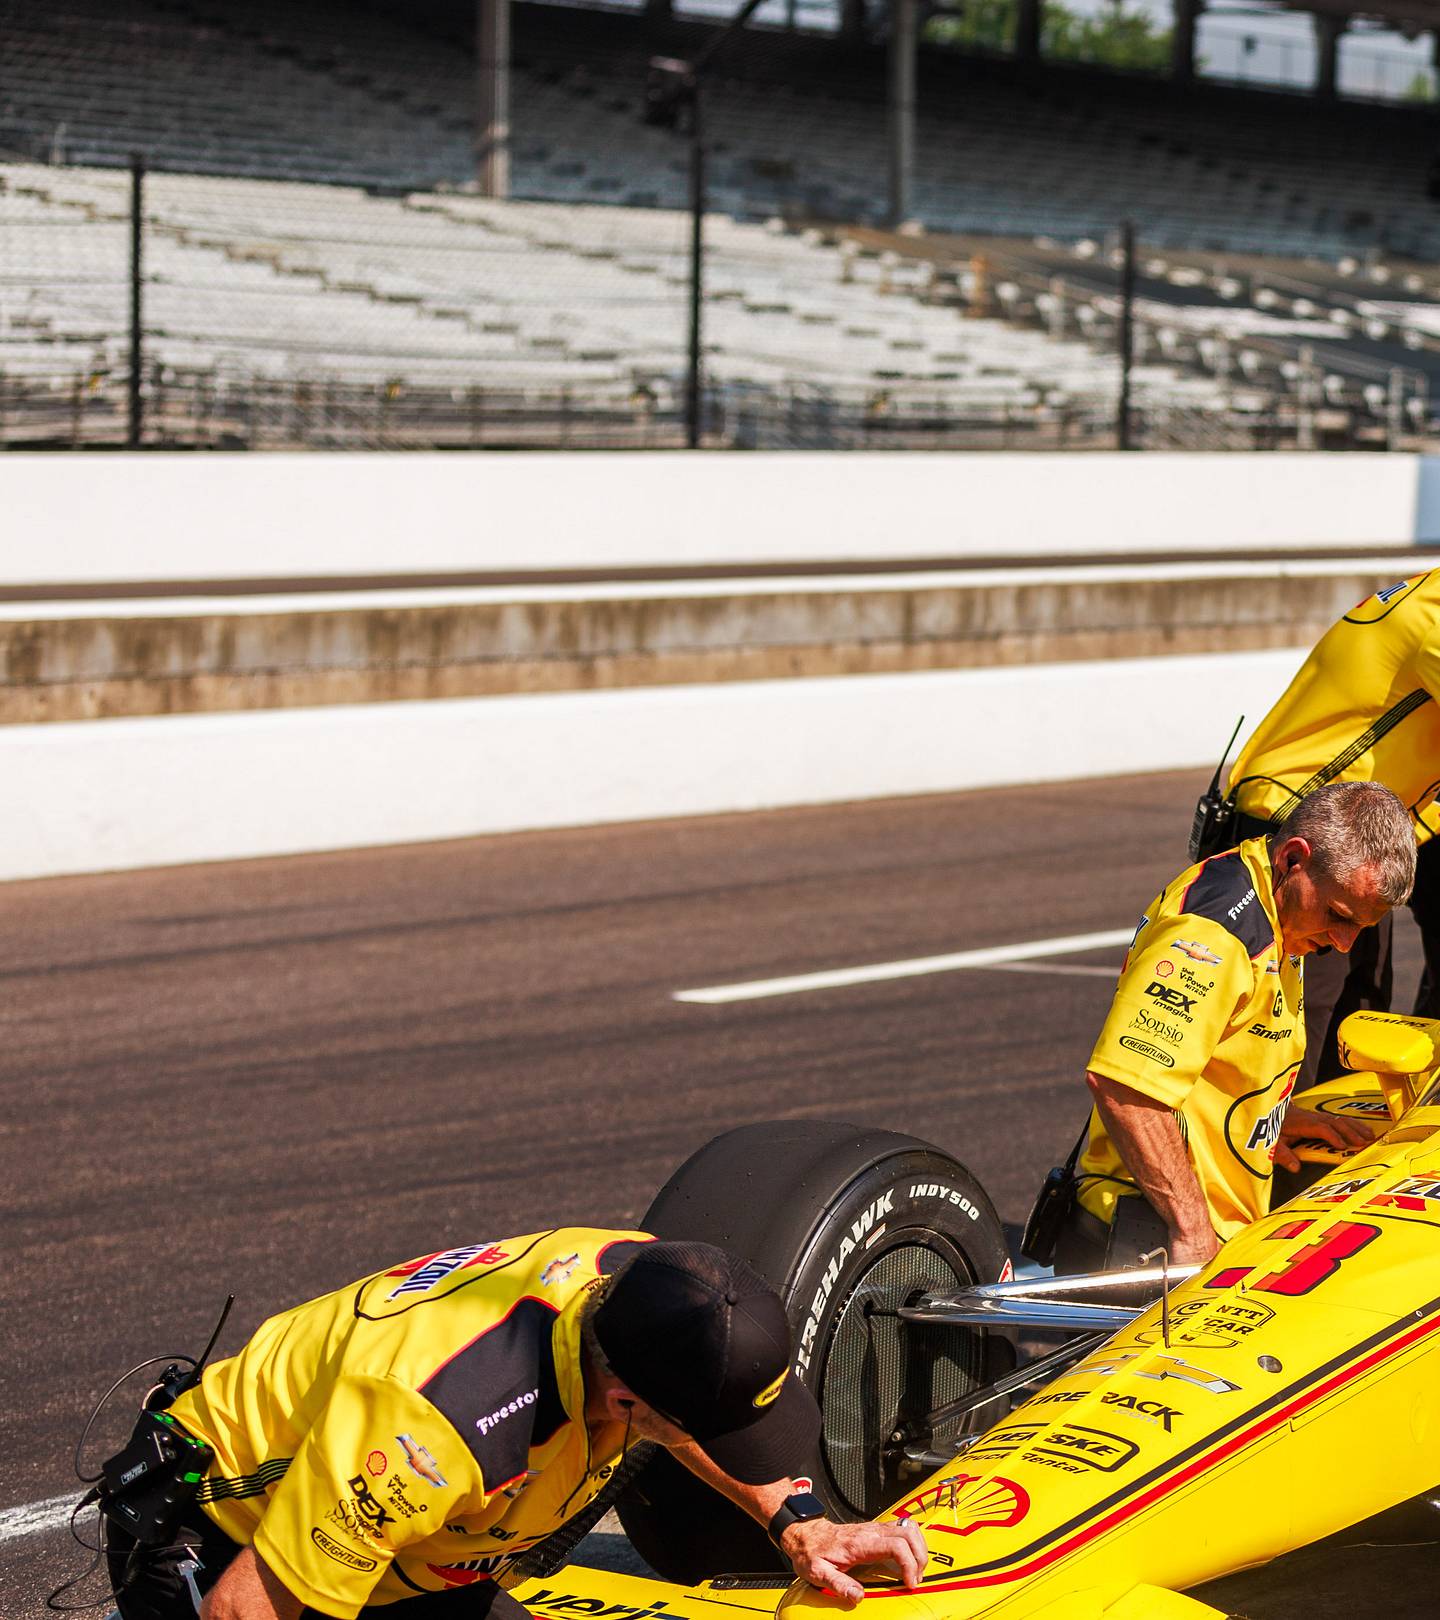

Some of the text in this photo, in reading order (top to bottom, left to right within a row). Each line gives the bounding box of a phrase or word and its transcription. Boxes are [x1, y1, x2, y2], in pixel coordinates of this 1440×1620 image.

[1182, 967, 1195, 976] Shell
[1143, 981, 1198, 1014] DEX
[1153, 998, 1194, 1024] imaging
[1354, 1015, 1430, 1028] SIEMENS
[1135, 1008, 1184, 1043] Sonsio
[1124, 1039, 1172, 1065] FREIGHTLINER
[1203, 1219, 1383, 1297] 3
[1216, 1304, 1264, 1320] NTT
[1150, 1317, 1256, 1337] INDCAR
[348, 1473, 397, 1529] DEX
[314, 1533, 373, 1569] FREIGHTLINER
